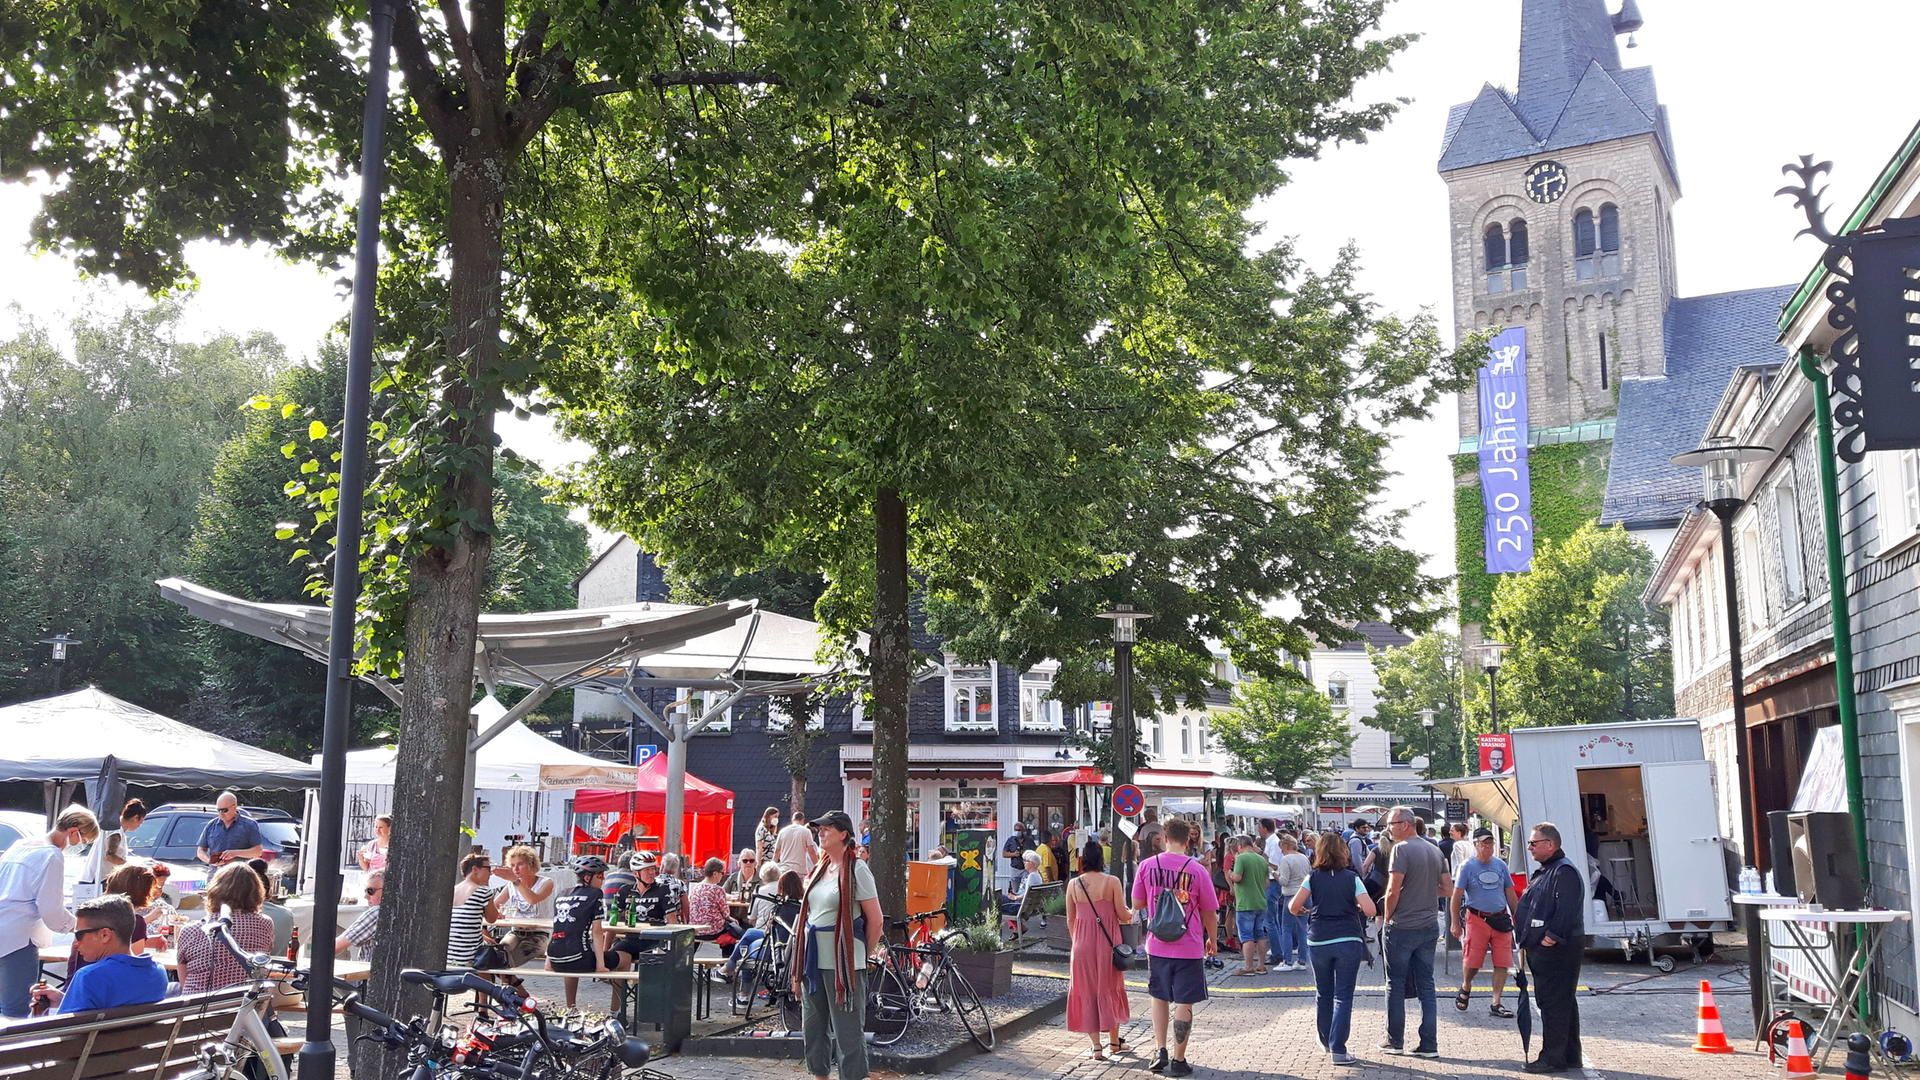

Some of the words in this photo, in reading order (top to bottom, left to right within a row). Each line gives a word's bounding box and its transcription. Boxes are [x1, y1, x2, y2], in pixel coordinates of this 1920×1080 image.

[1541, 164, 1549, 172] 12
[1536, 194, 1541, 202] 7
[1486, 391, 1519, 481] Jahre
[1495, 492, 1528, 552] 250
[639, 748, 651, 764] P
